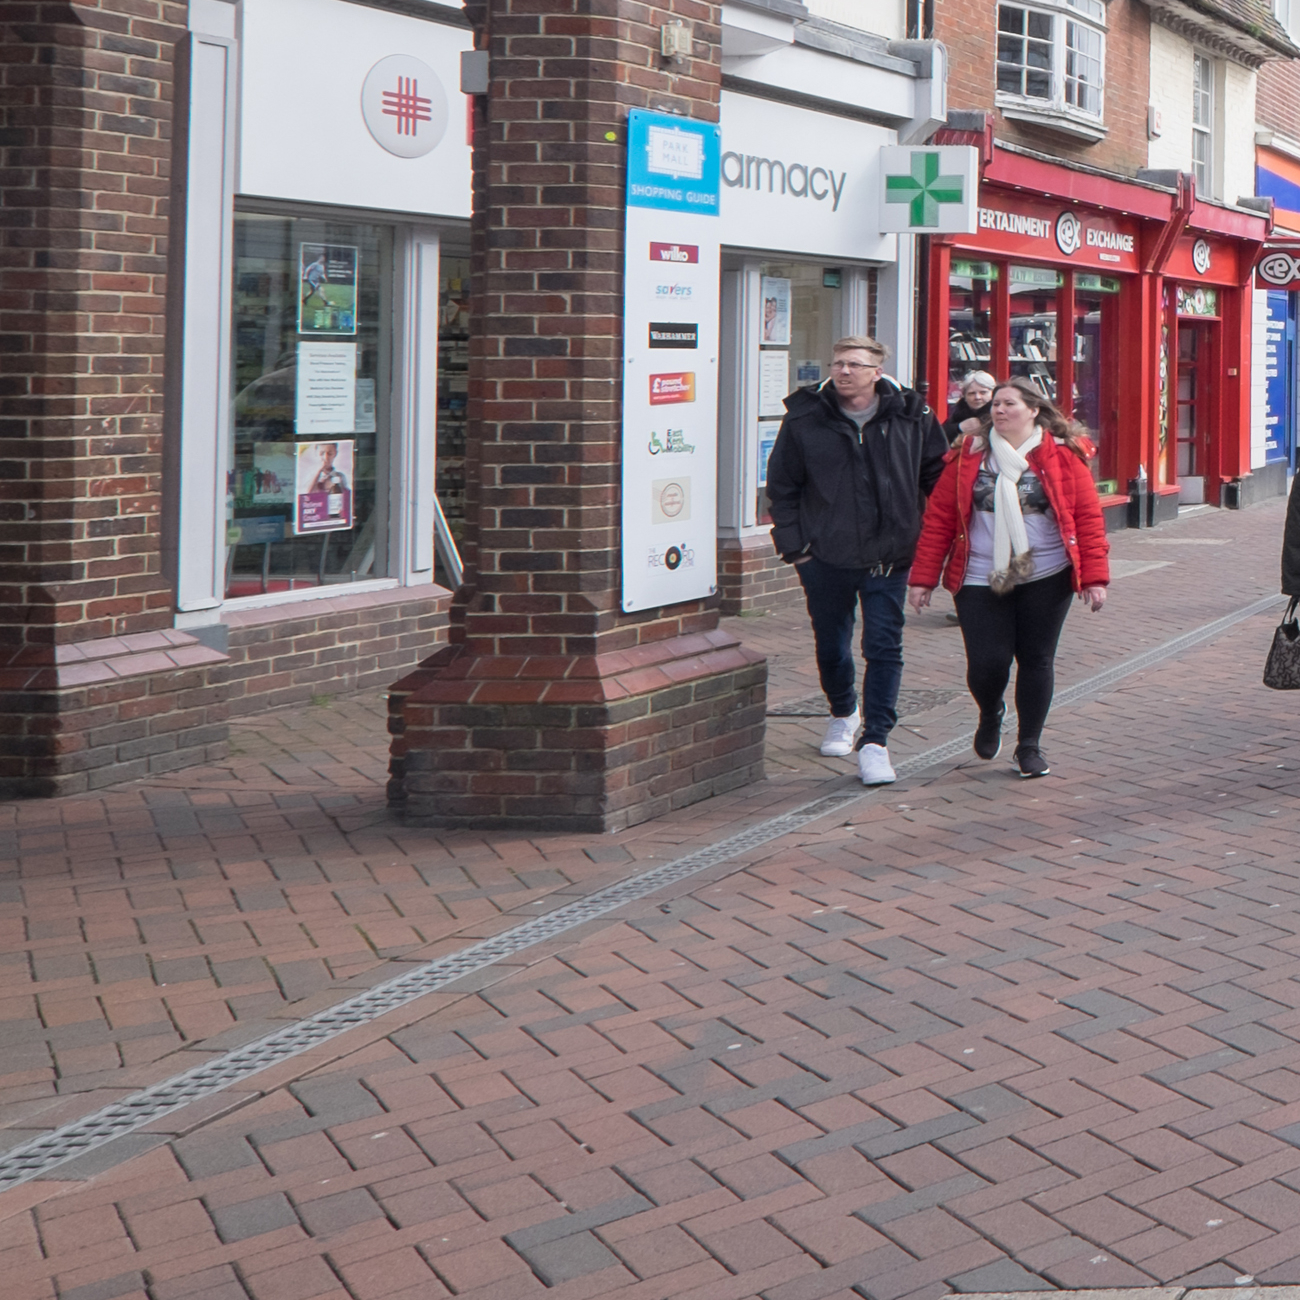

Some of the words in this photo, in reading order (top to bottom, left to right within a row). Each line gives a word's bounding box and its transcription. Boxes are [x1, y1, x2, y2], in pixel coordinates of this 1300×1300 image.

[663, 140, 689, 154] PARK
[662, 153, 689, 166] MALL
[720, 151, 847, 212] armacy
[631, 184, 682, 201] SHOPPING
[686, 191, 716, 205] GUIDE
[977, 207, 1051, 239] ERTAINMENT
[1086, 228, 1134, 253] EXCHANGE
[660, 245, 689, 262] wilko
[655, 282, 692, 296] savers
[650, 331, 697, 341] WARHAMMER
